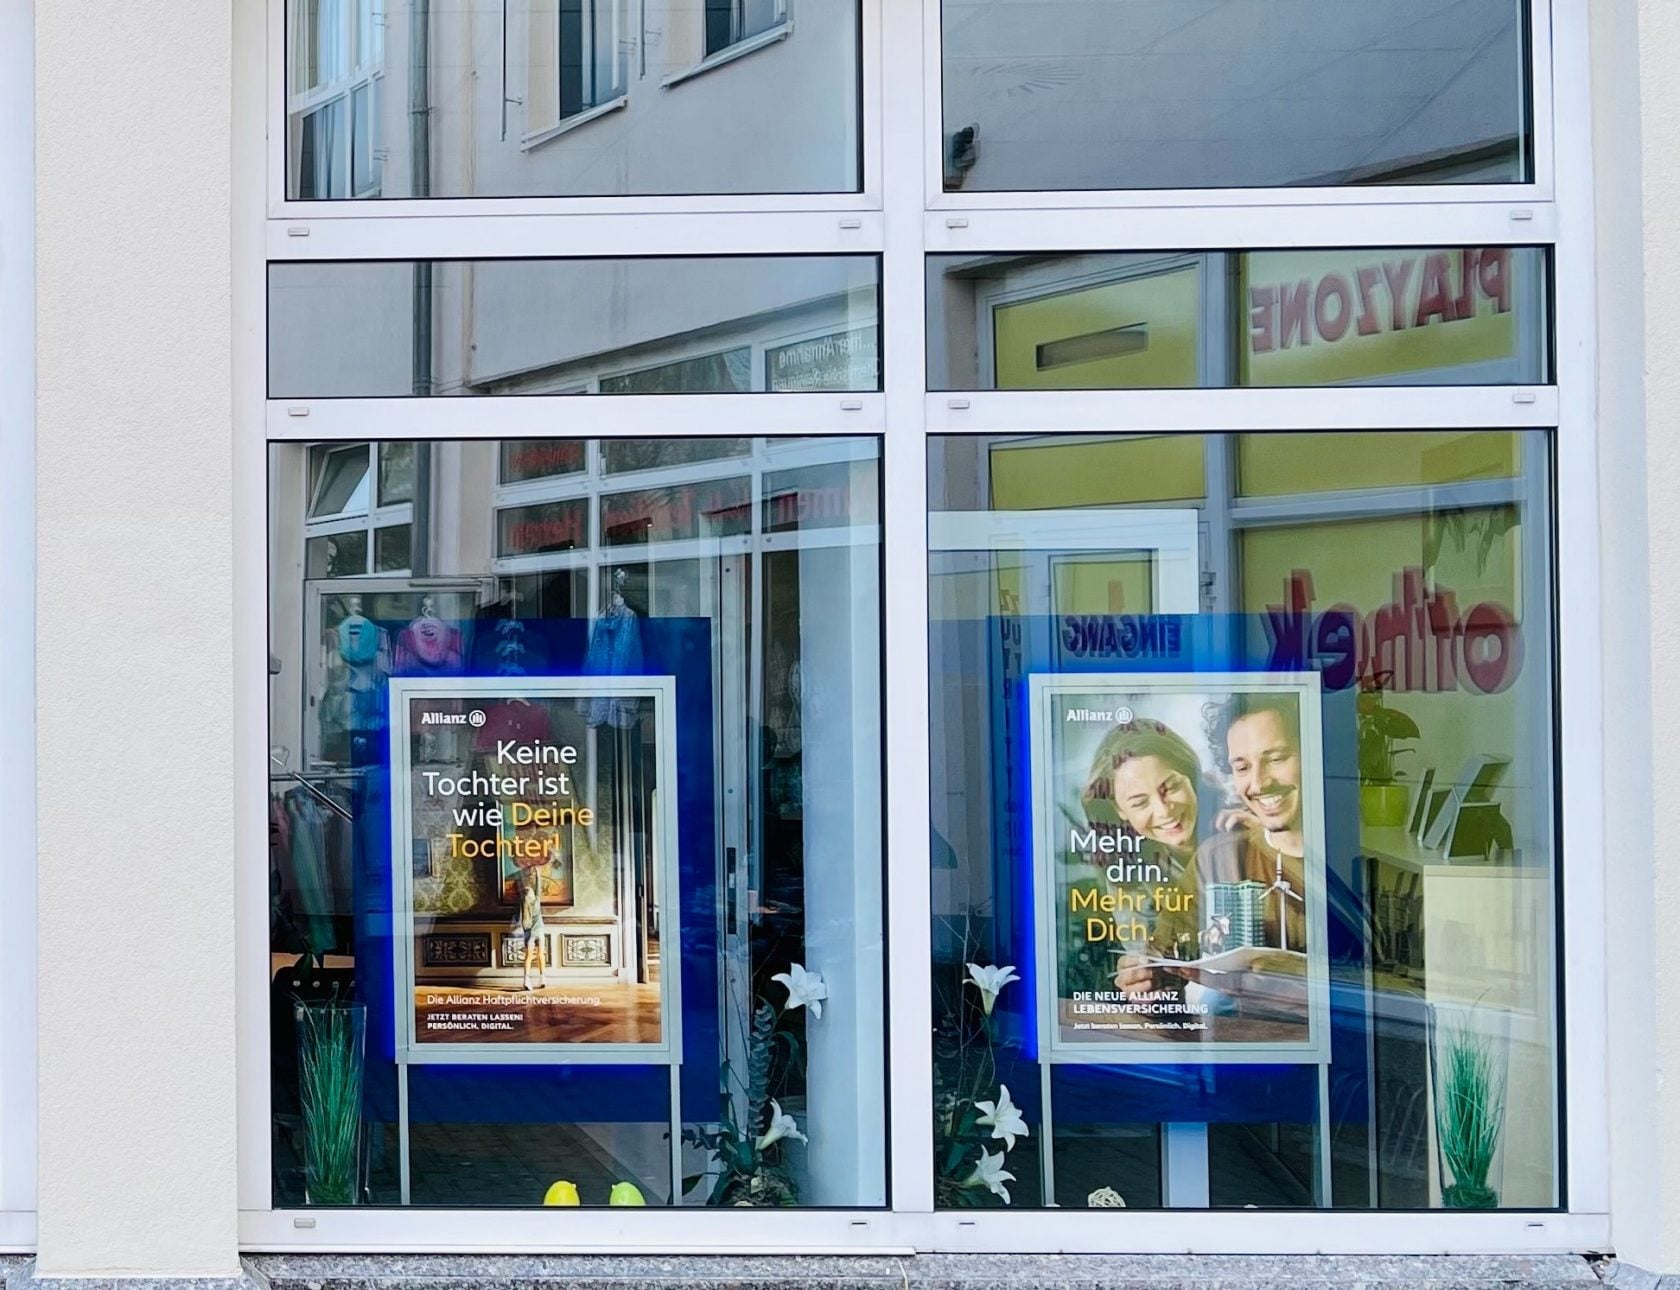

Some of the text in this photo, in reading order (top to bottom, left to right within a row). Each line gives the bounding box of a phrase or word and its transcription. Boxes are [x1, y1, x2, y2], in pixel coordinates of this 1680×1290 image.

[421, 712, 467, 724] Allianz
[1066, 709, 1113, 721] Allianz
[497, 740, 577, 765] Keine
[423, 771, 570, 796] Tochter ist
[452, 802, 595, 827] wie Deine
[446, 834, 561, 859] Tochter!
[1070, 829, 1146, 854] Mehr
[1106, 858, 1169, 883] drin.
[1071, 888, 1194, 912] Mehr für
[1086, 918, 1155, 942] Dich.
[427, 995, 443, 1005] Die
[445, 995, 480, 1005] Allianz
[1073, 991, 1179, 1001] DIE NEUE ALLIANZ
[427, 1013, 523, 1021] JETZT BERATEN LASSEN!
[1073, 1004, 1209, 1015] LEBENSVERSICHERUNG
[481, 1022, 514, 1030] DIGITAL.
